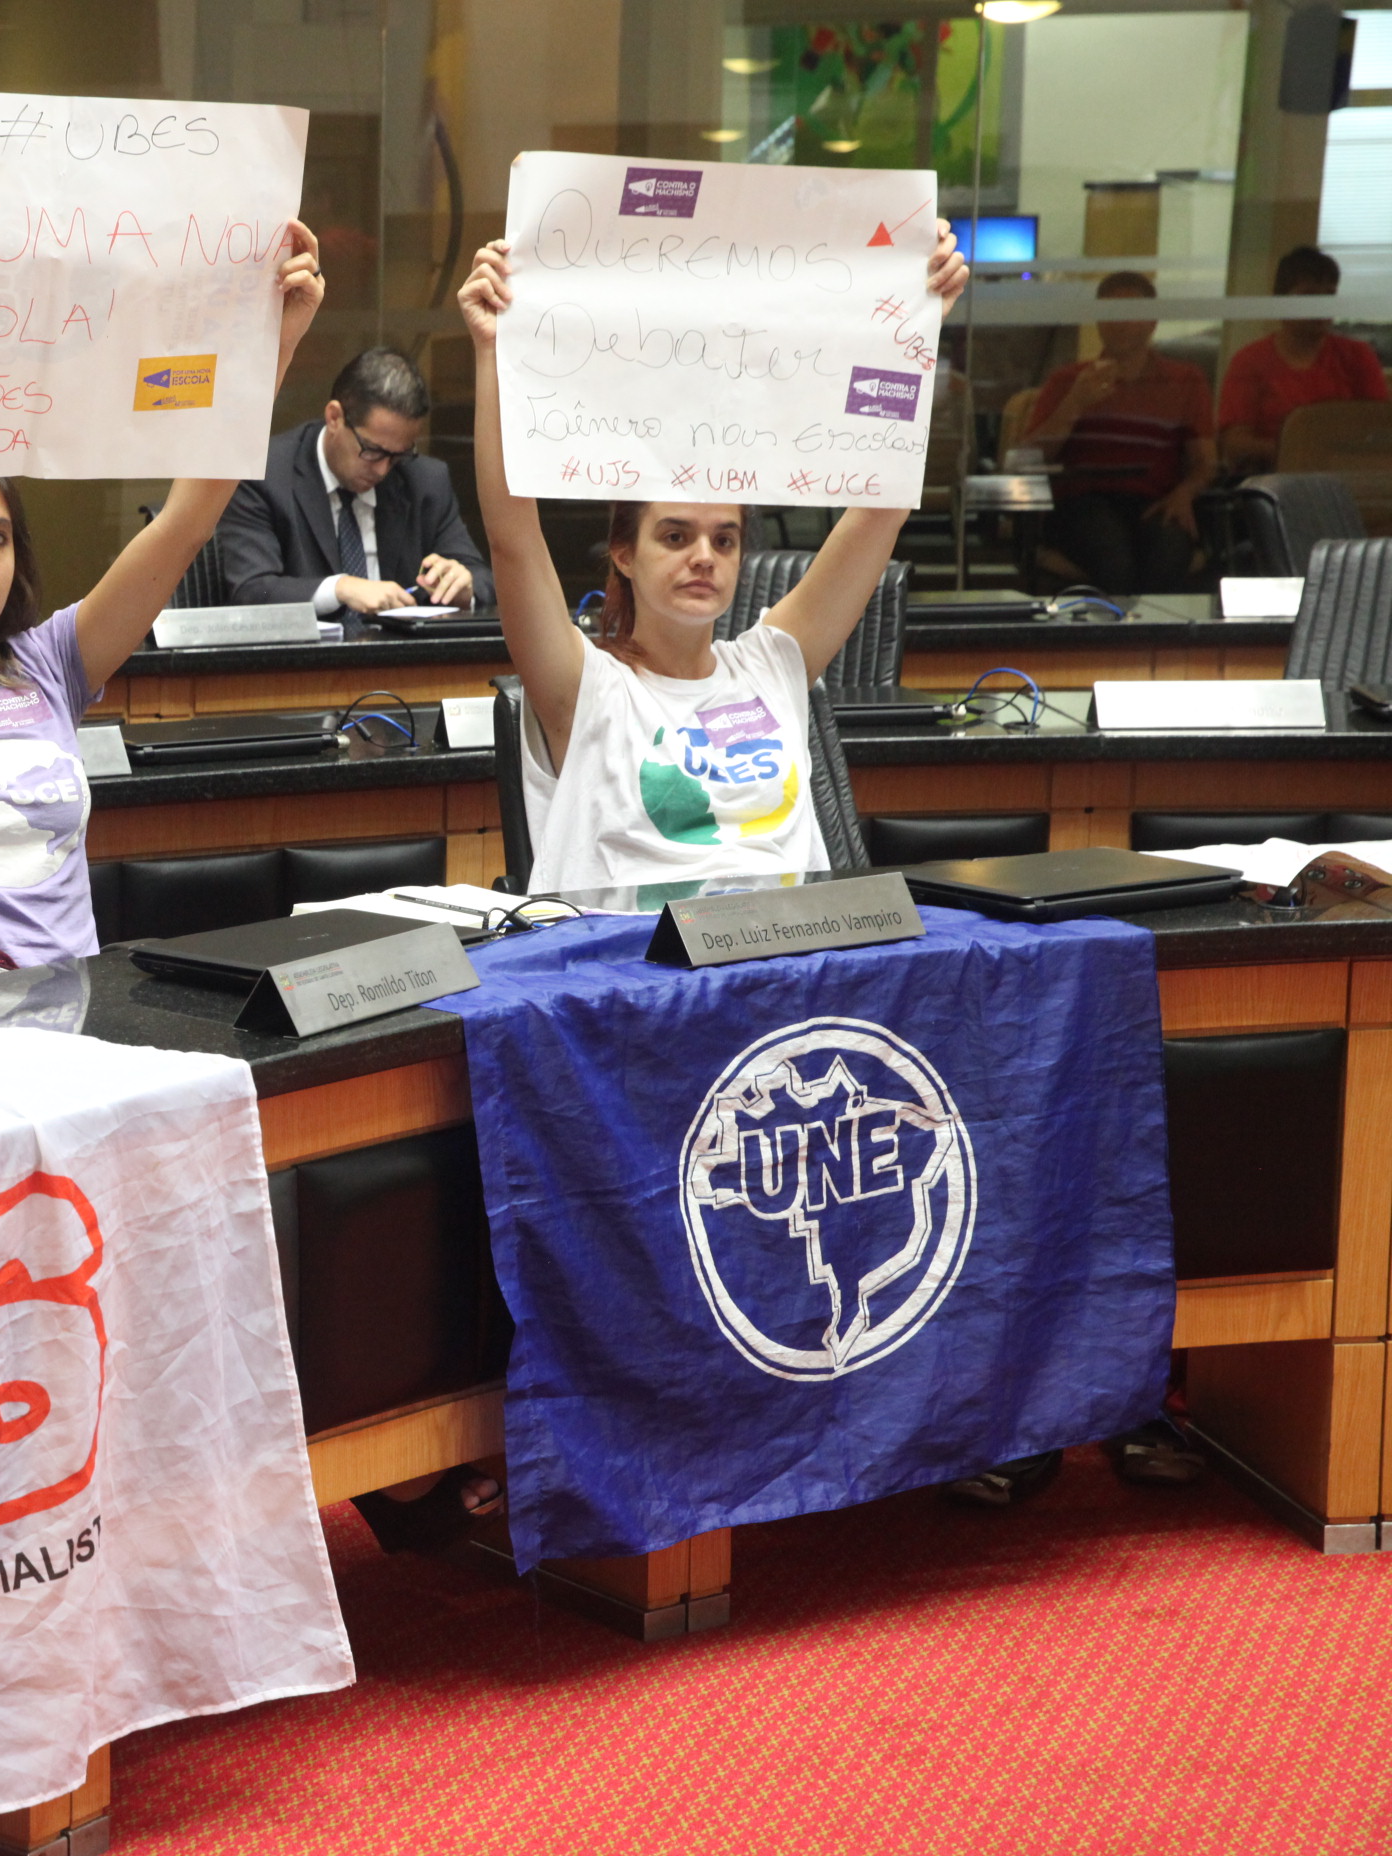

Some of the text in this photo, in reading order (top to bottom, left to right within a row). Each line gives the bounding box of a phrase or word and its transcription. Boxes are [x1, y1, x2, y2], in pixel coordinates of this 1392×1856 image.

[656, 180, 696, 190] CONTRA O
[655, 188, 695, 197] MACHISMO
[172, 375, 210, 386] ESCOLA
[879, 381, 917, 393] CONTRA O
[878, 389, 915, 400] MACHISMO
[560, 456, 883, 497] #UJS #UBM #UCE
[29, 691, 38, 699] O
[0, 697, 40, 712] MACHISMO
[701, 908, 903, 952] Dep. Luiz Fernando Vampiro
[327, 967, 438, 1012] Dep. Romildo Titon
[740, 1107, 905, 1221] UNE
